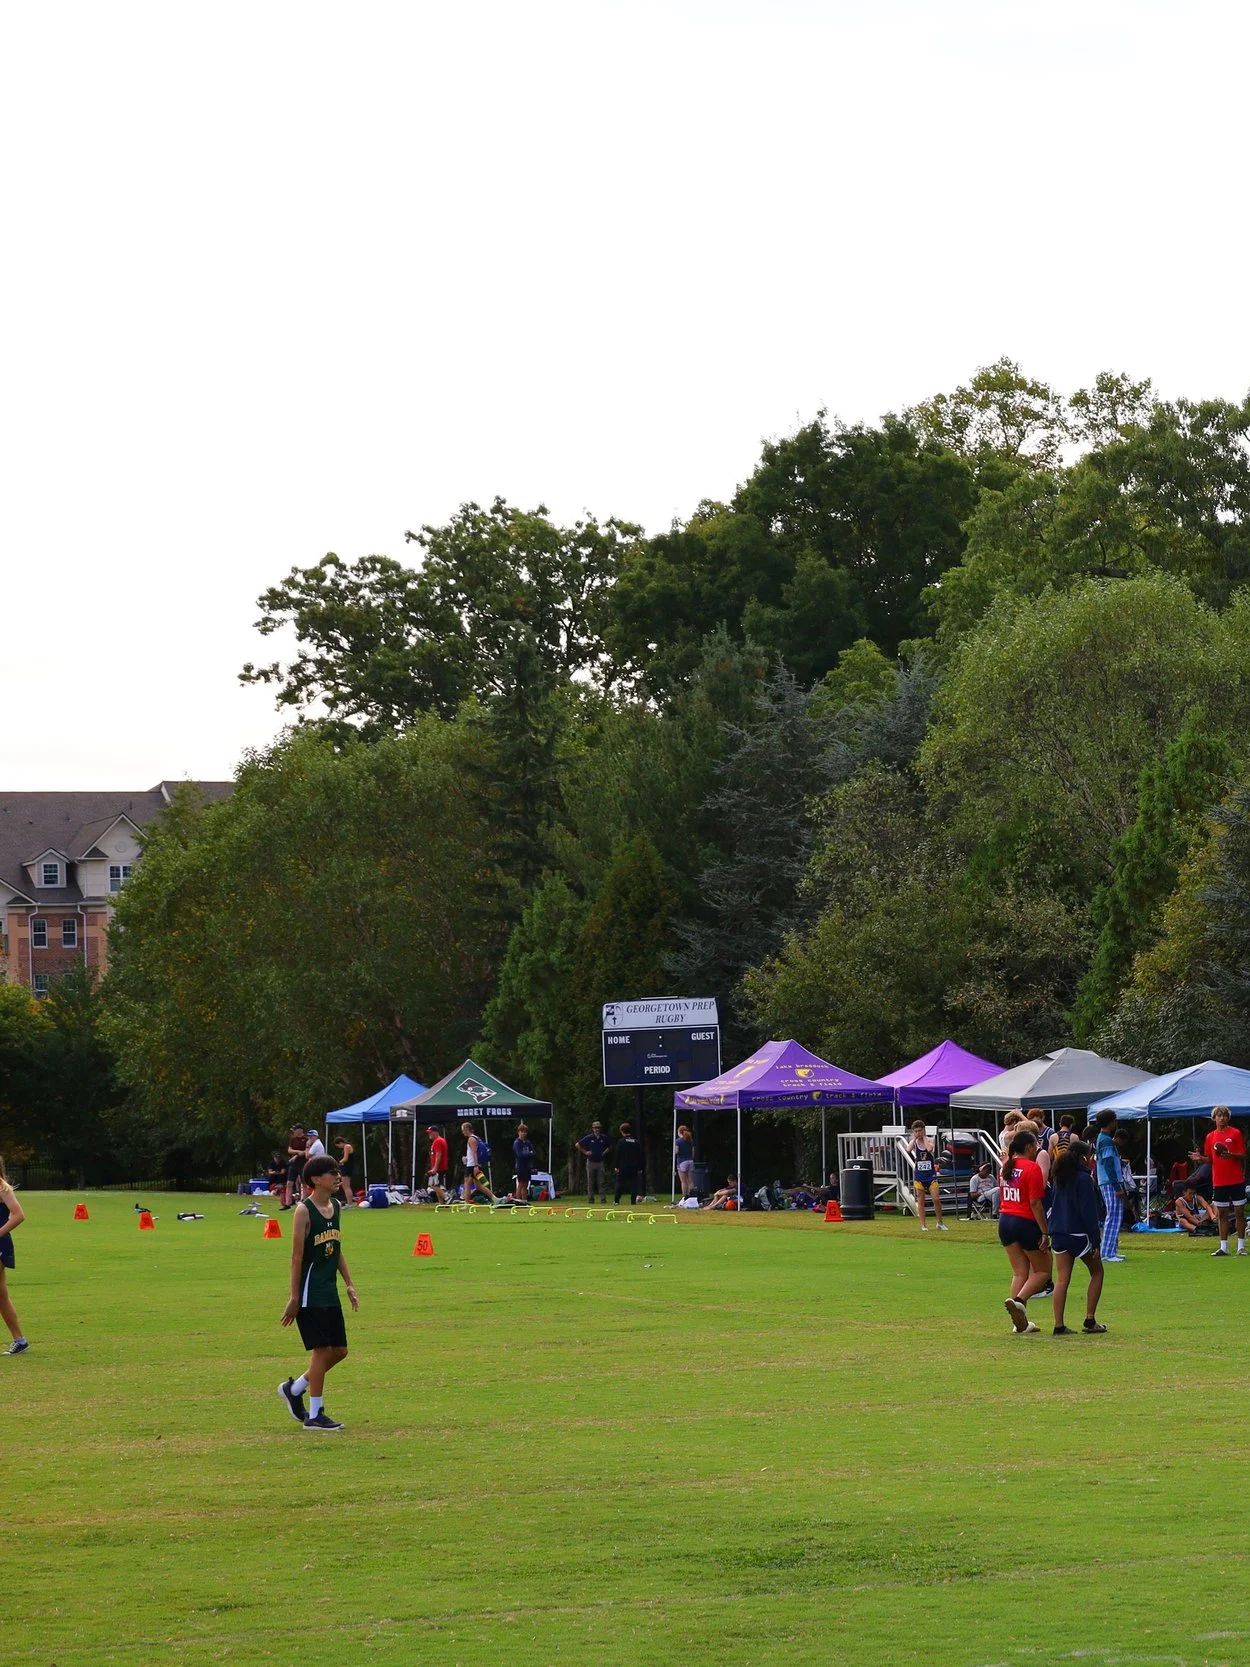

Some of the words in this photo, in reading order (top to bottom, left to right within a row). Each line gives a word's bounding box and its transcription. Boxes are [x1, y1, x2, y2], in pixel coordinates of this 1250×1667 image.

[626, 1001, 690, 1014] GEORGETOWN
[691, 1000, 715, 1011] PREP
[655, 1014, 686, 1024] RUGBY
[607, 1035, 631, 1045] HOME
[691, 1031, 715, 1041] GUEST
[644, 1065, 671, 1075] PERIOD
[457, 1108, 484, 1117] MARET
[486, 1107, 512, 1116] FROGS
[417, 1240, 428, 1251] 50
